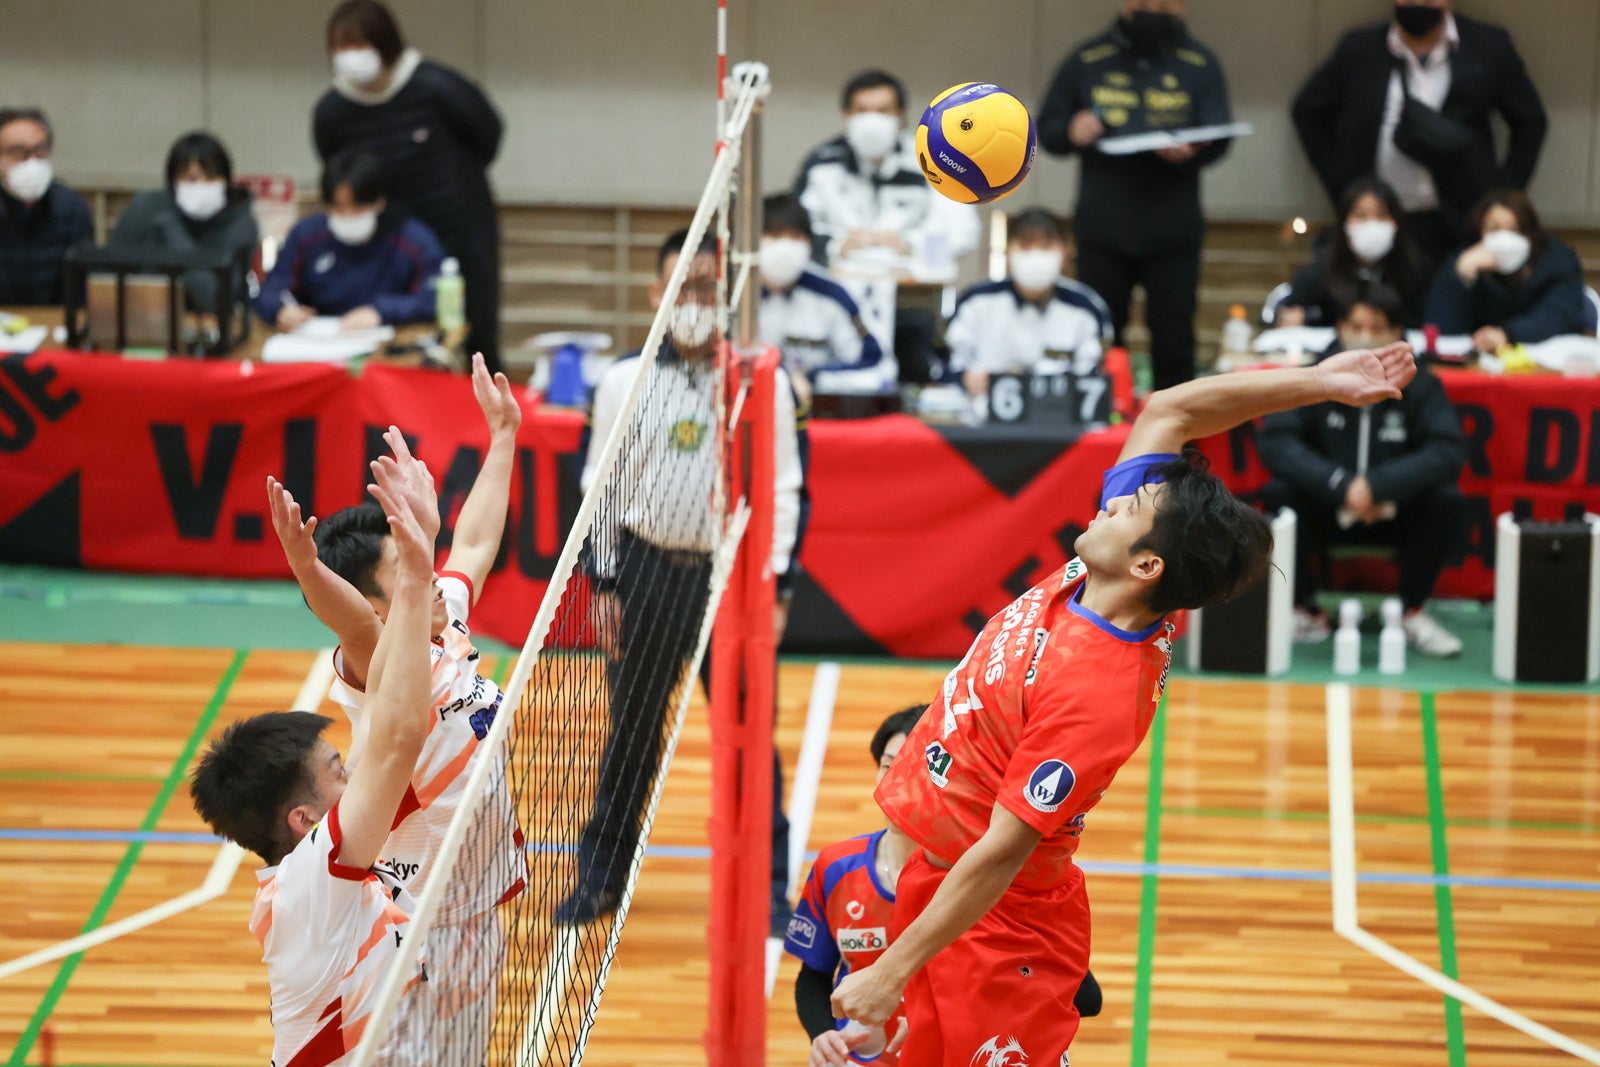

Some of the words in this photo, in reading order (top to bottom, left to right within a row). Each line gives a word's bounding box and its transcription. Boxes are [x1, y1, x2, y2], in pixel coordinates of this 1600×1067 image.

[938, 150, 967, 174] V200W
[991, 376, 1024, 422] 6
[1075, 377, 1107, 421] 7
[1015, 588, 1045, 646] NAGANO
